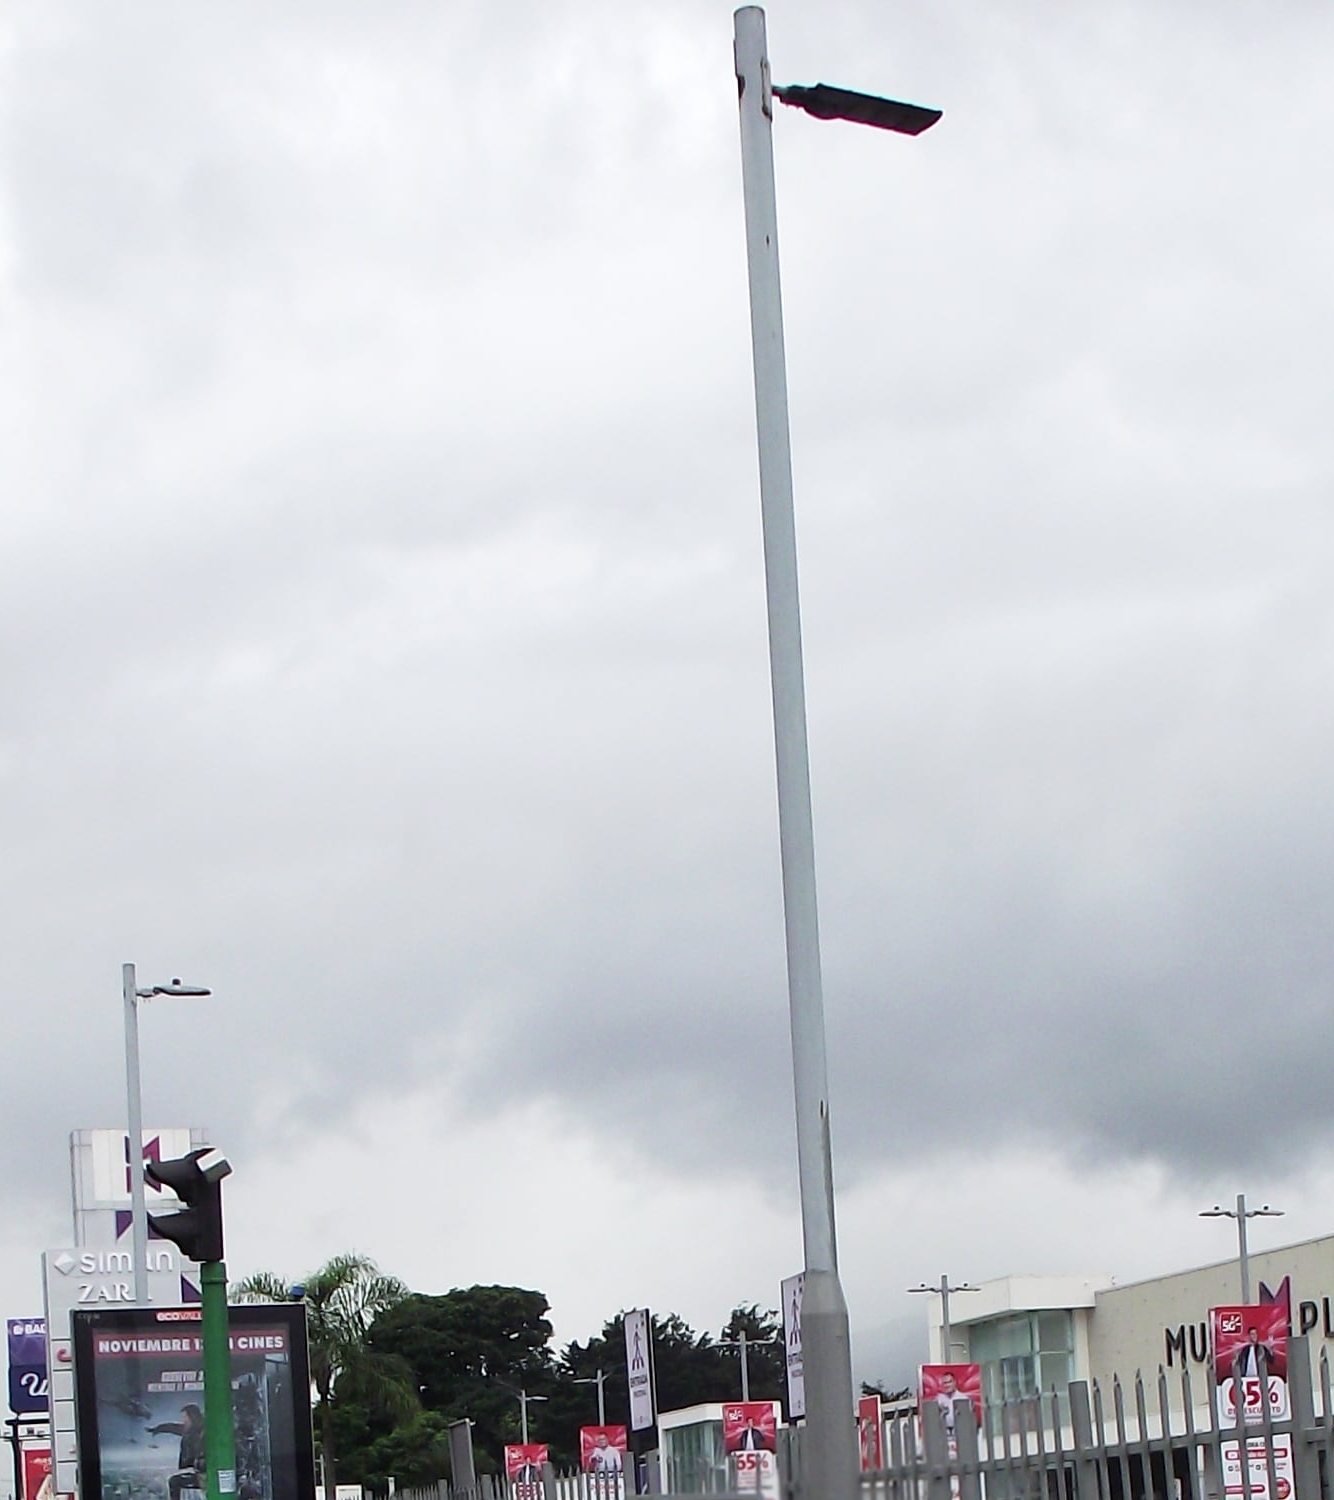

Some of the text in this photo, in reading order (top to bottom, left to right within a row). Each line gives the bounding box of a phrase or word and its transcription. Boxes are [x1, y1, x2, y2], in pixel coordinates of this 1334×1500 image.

[77, 1283, 153, 1303] ZAR
[99, 1338, 190, 1353] NOVIEMBRE
[238, 1335, 284, 1350] CINES
